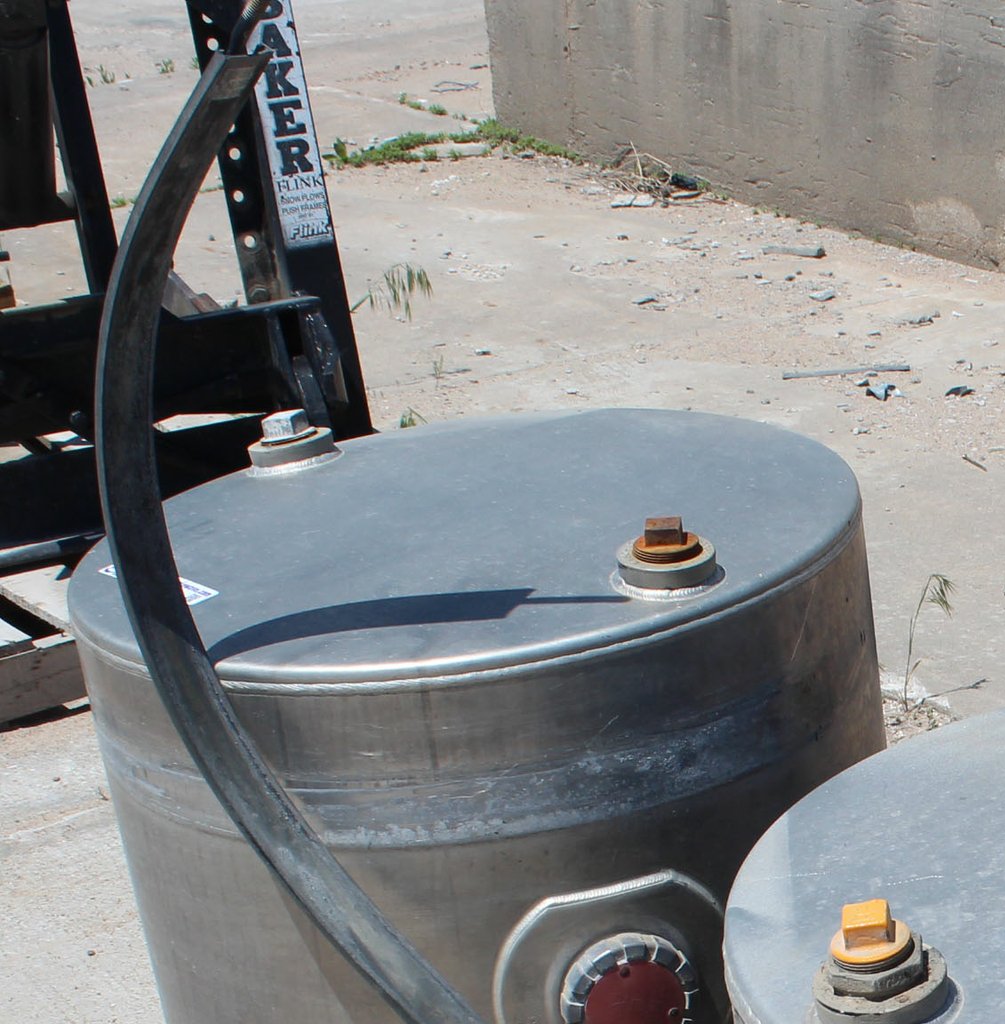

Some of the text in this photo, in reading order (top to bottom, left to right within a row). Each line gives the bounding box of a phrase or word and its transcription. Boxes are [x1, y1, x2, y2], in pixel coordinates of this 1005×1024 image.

[277, 175, 323, 192] FLINK
[301, 192, 325, 201] PLOWS
[282, 202, 327, 214] PUSH FRAMES
[290, 222, 330, 239] Flink
